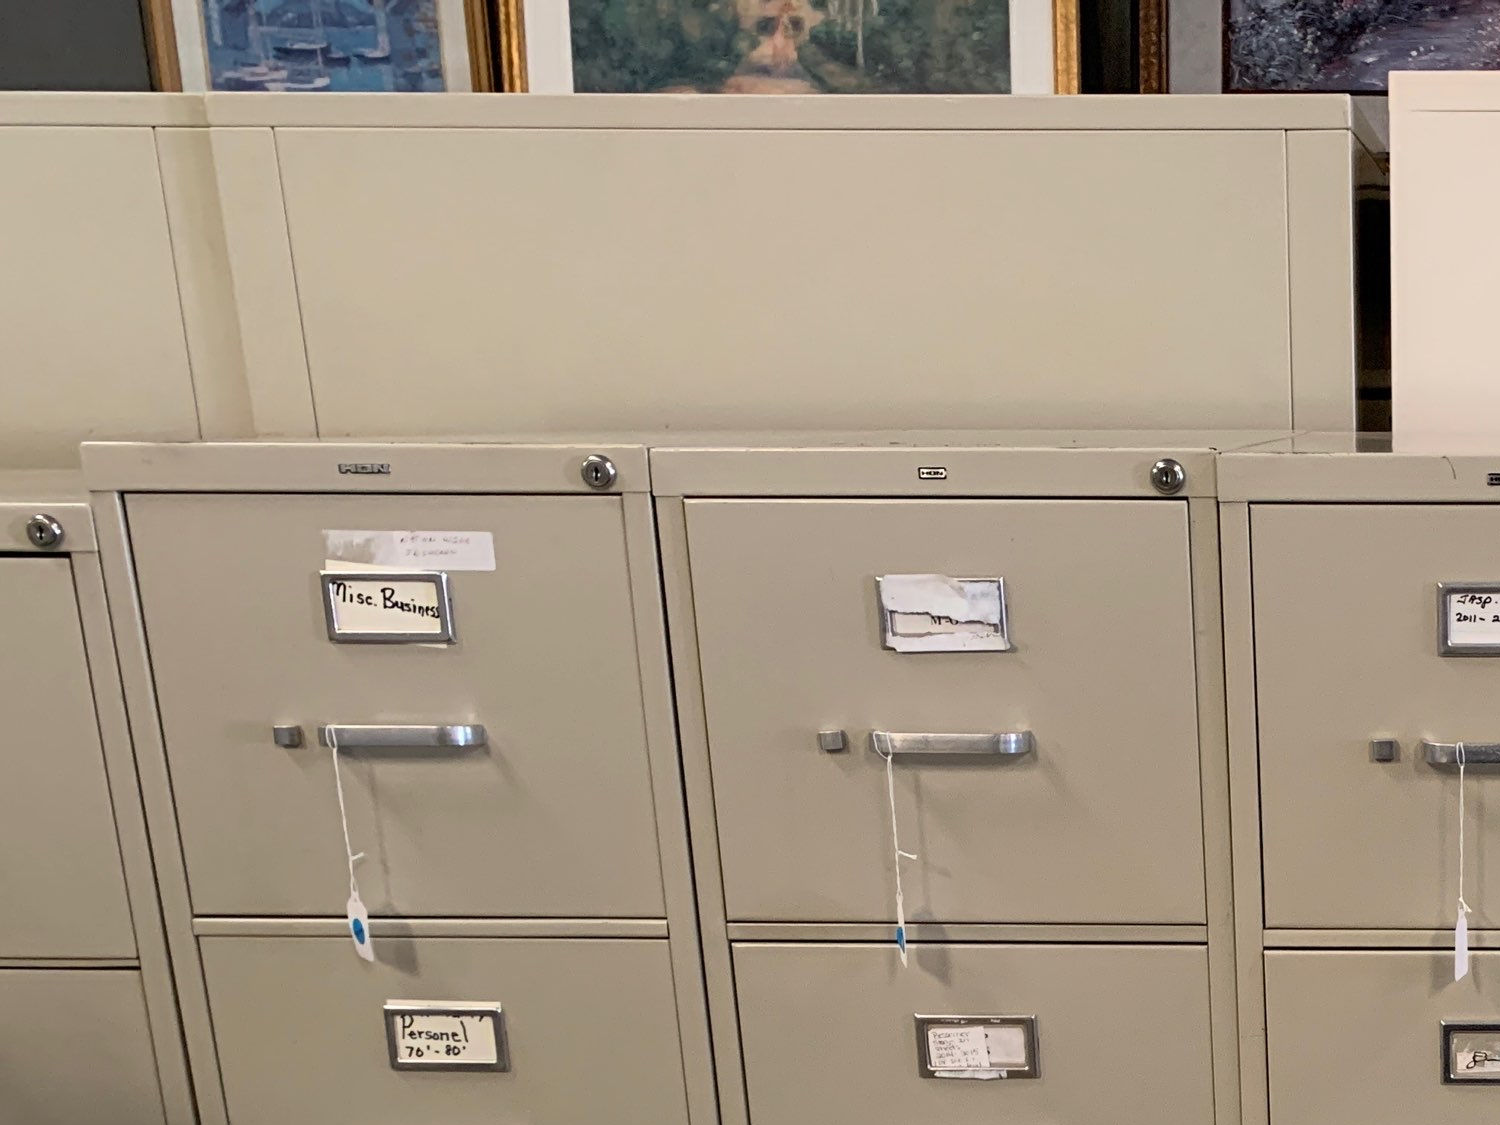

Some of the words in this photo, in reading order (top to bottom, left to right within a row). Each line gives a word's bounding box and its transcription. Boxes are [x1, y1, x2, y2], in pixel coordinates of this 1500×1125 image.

[337, 463, 391, 474] HON
[331, 581, 377, 607] Misc.
[380, 587, 441, 619] Business
[401, 1015, 469, 1042] Personel
